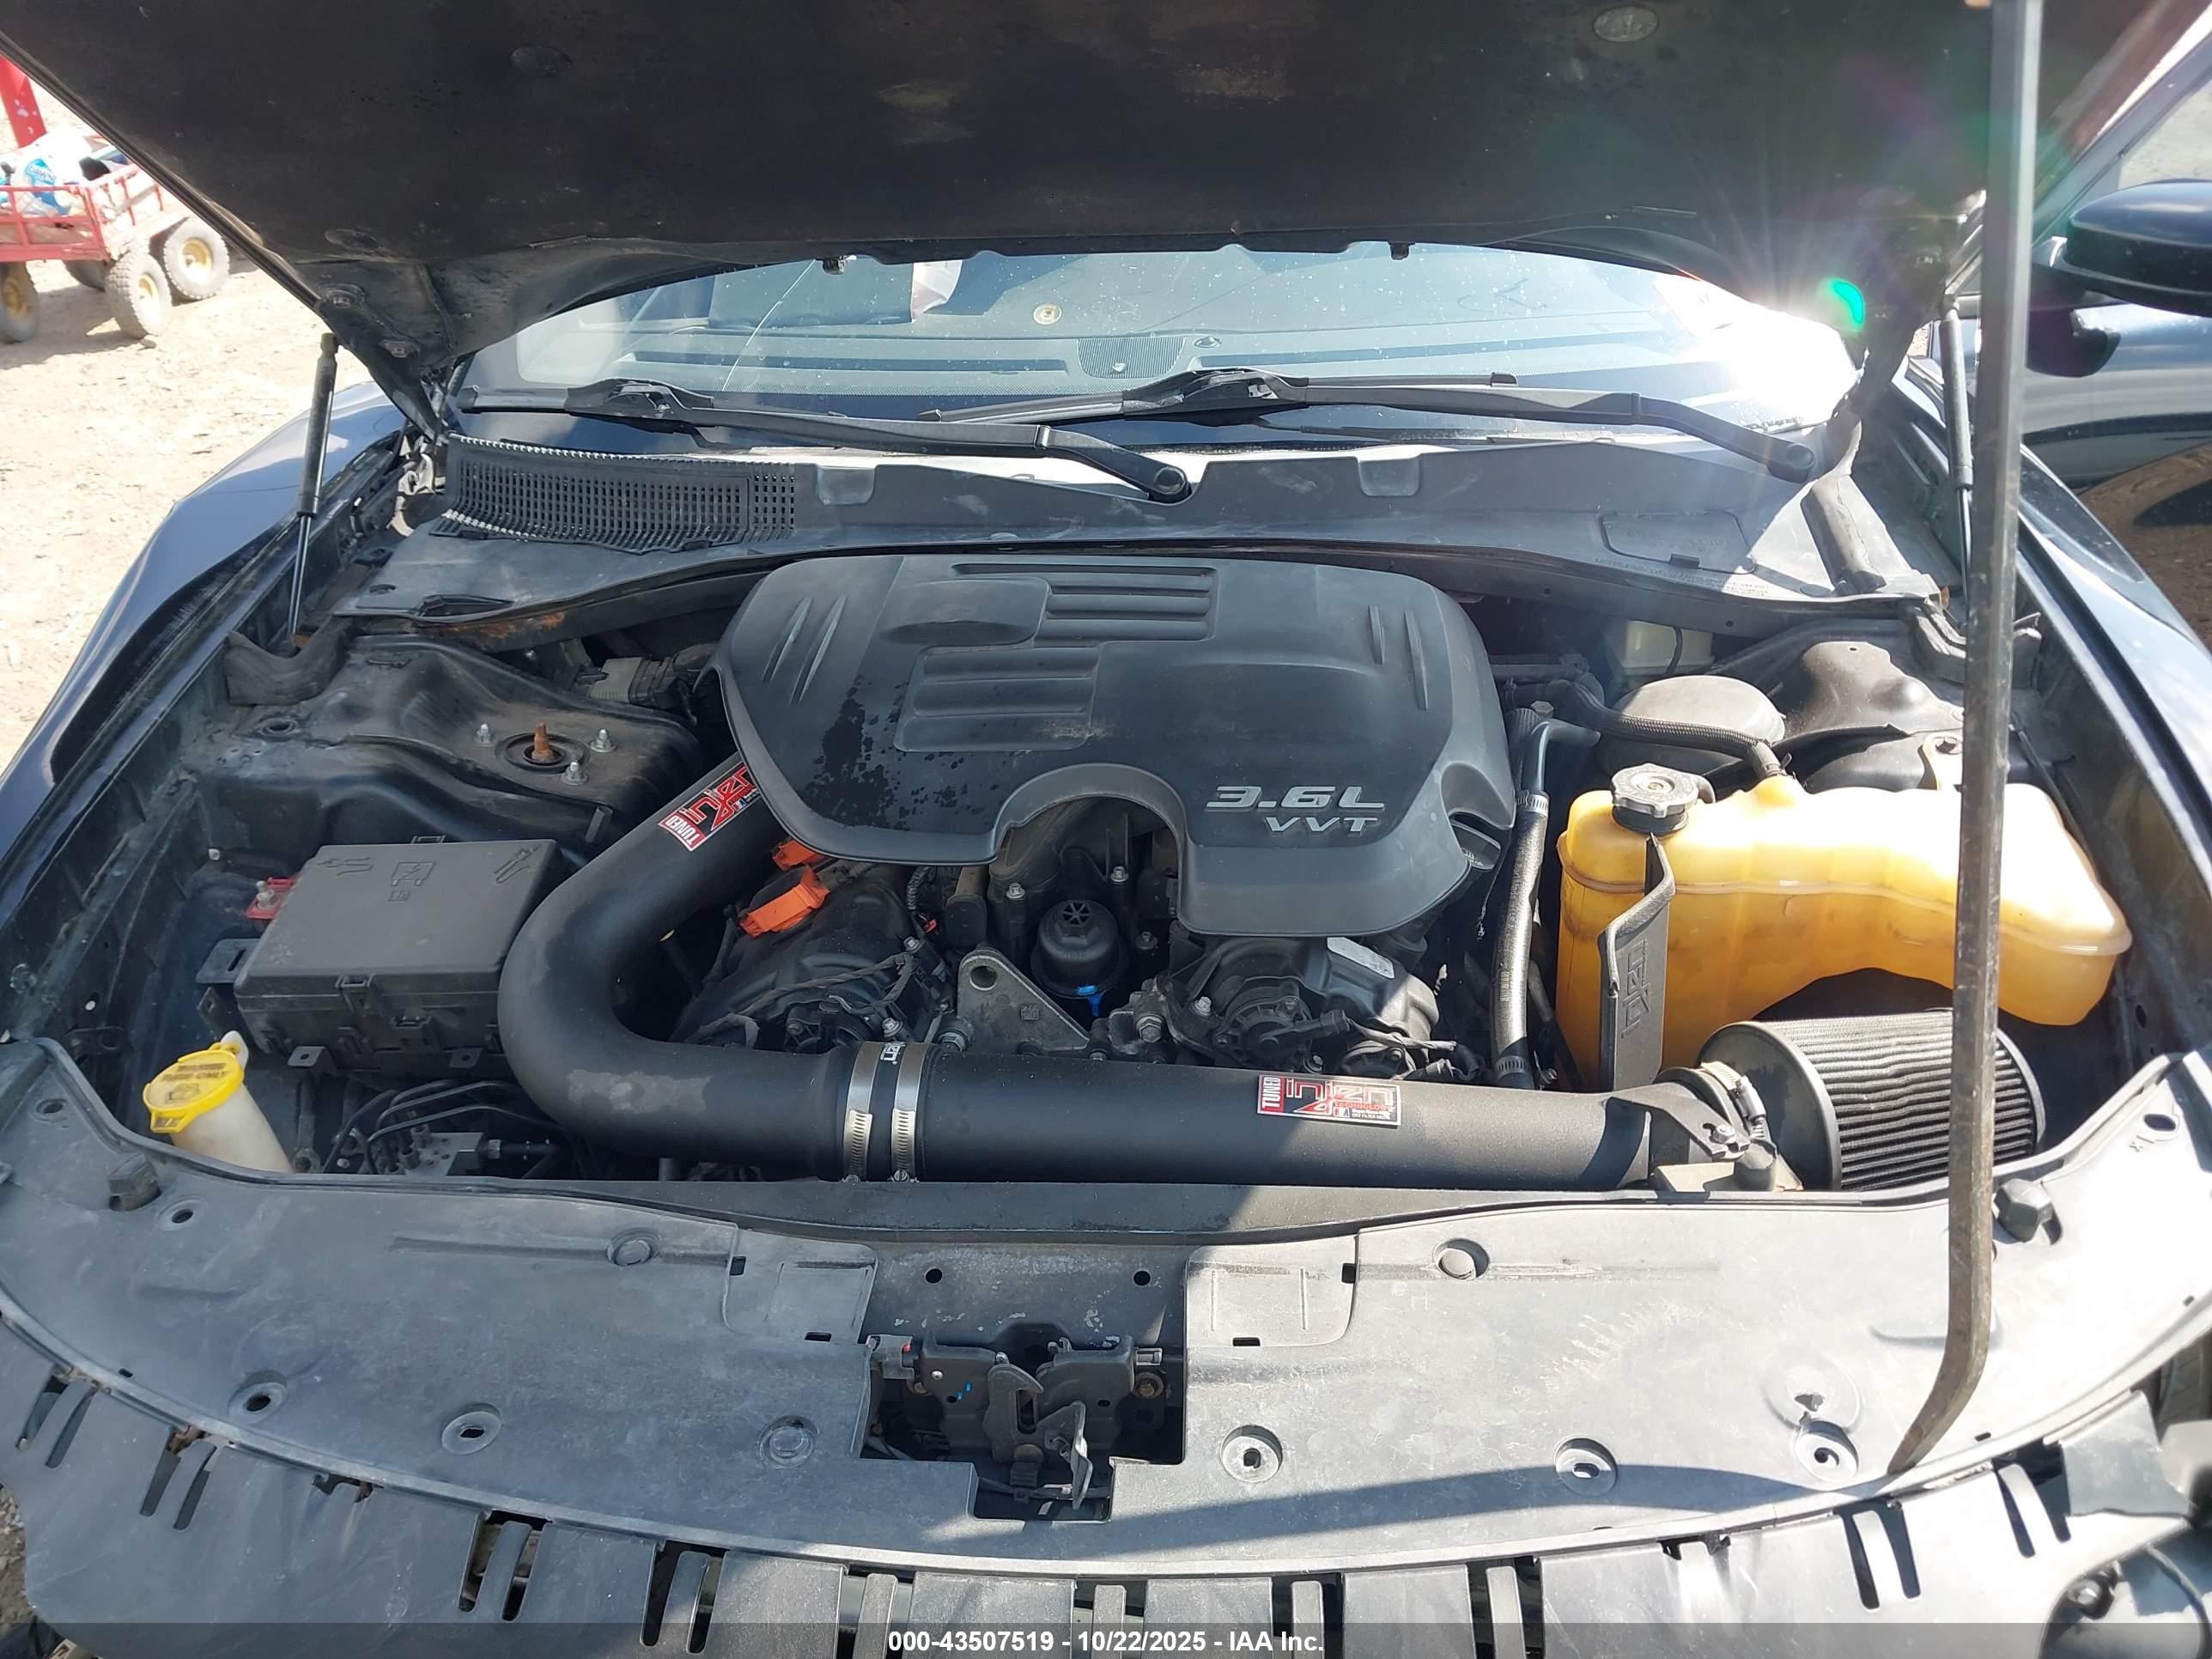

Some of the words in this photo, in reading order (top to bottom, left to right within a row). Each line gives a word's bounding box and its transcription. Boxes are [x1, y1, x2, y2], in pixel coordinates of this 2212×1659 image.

[1206, 786, 1384, 809] 3.6L
[665, 815, 701, 846] TUNED
[1265, 817, 1377, 832] VVT
[1262, 1077, 1281, 1109] TUNED
[1286, 1078, 1395, 1115] injen
